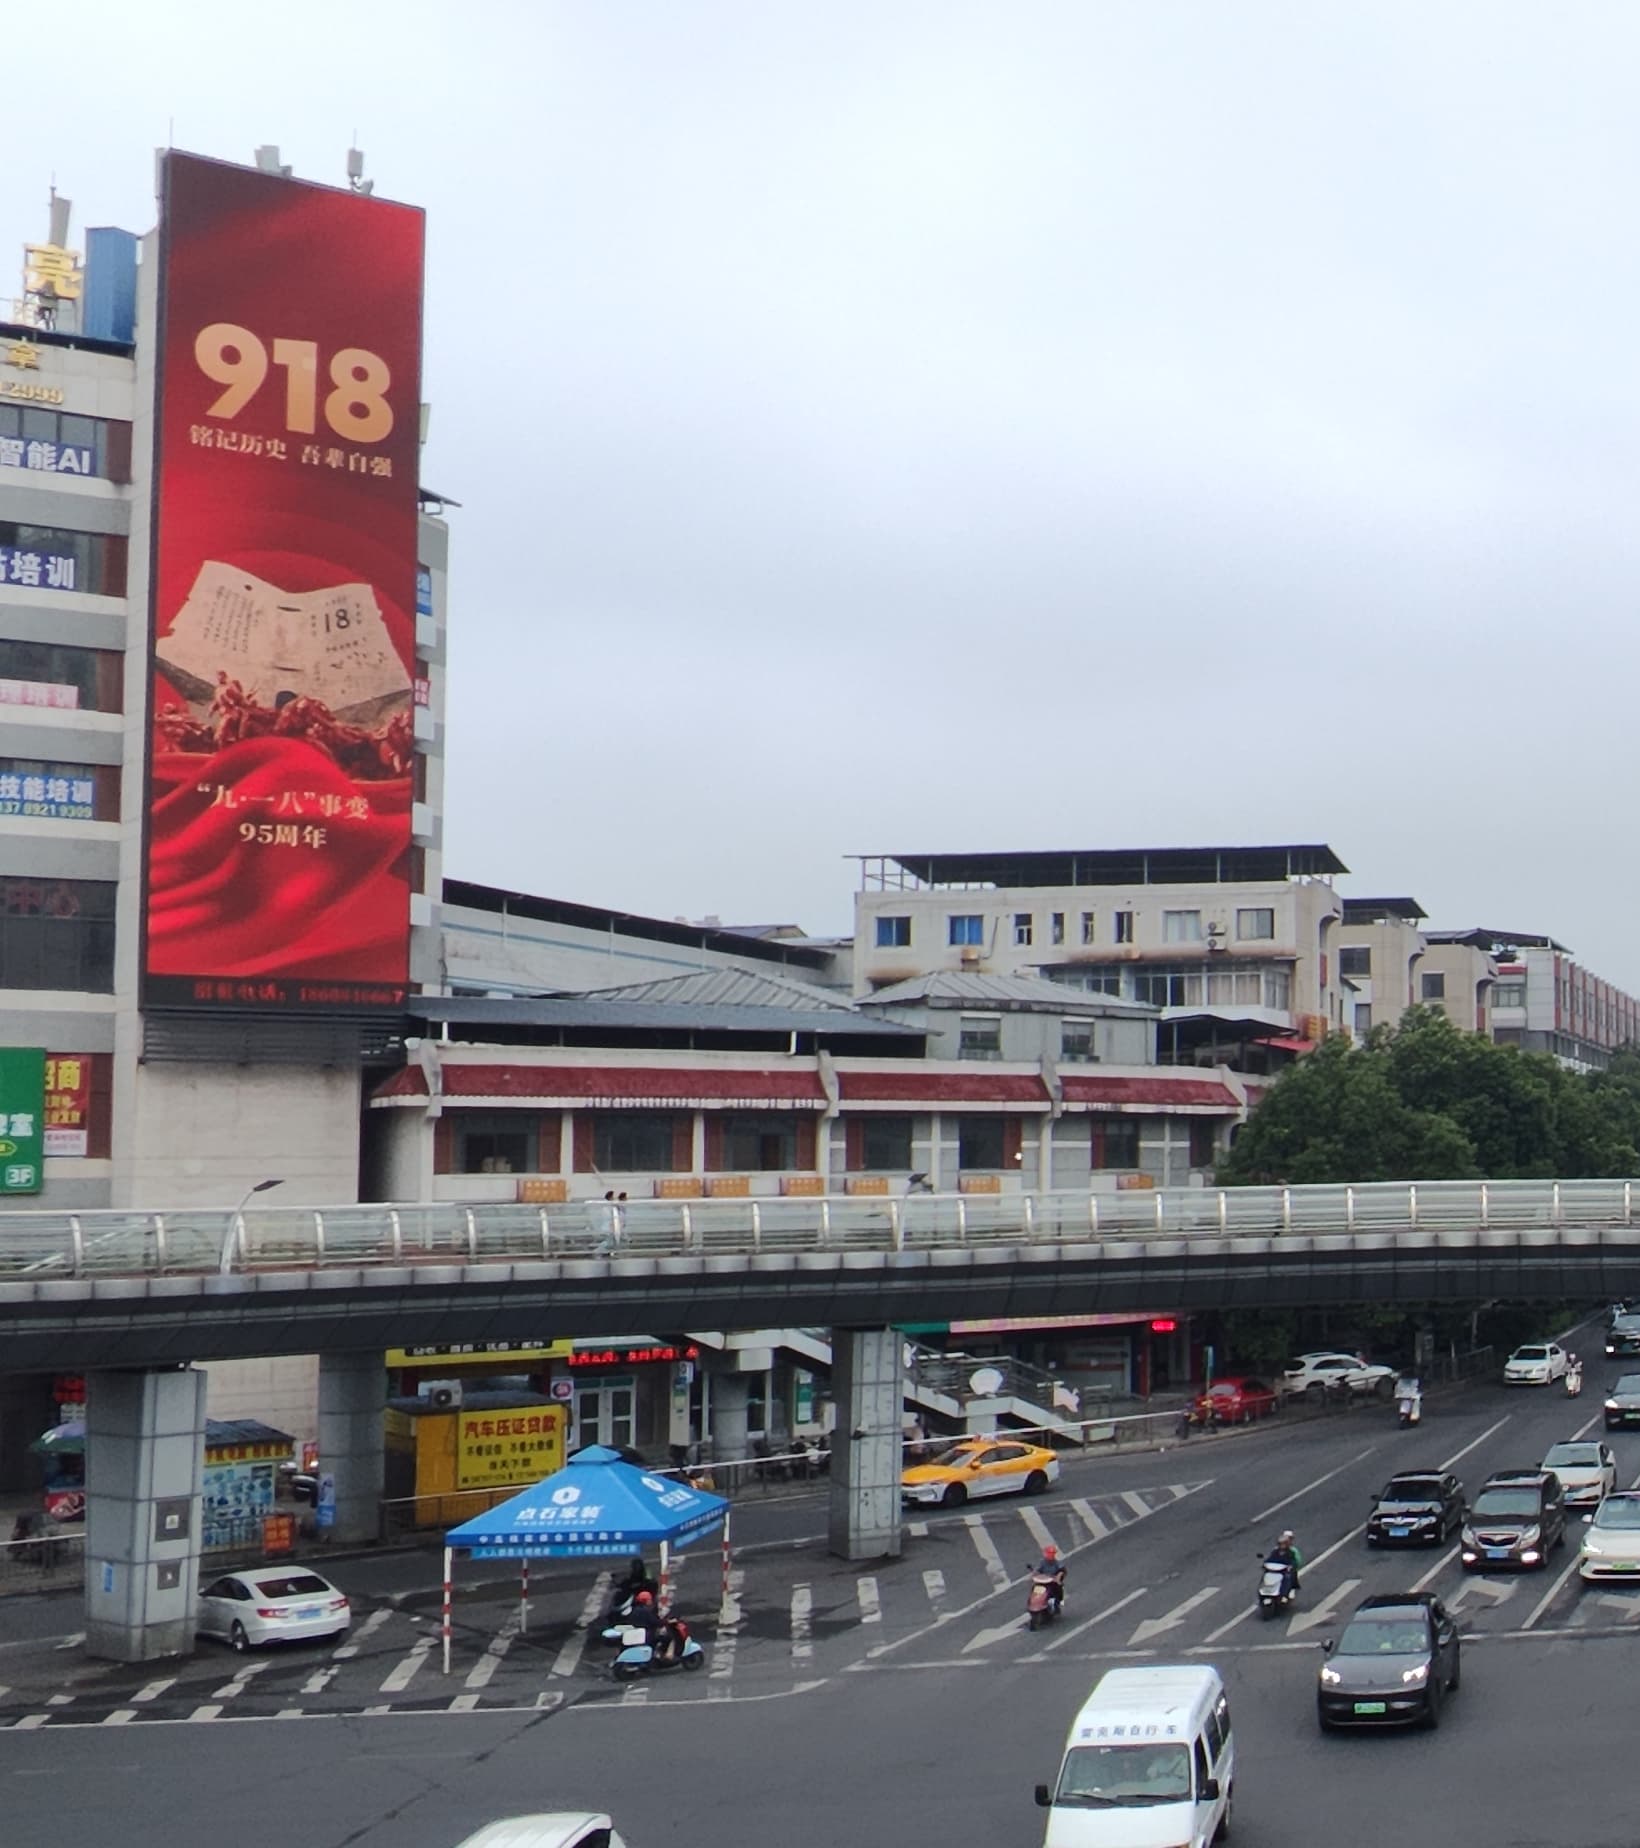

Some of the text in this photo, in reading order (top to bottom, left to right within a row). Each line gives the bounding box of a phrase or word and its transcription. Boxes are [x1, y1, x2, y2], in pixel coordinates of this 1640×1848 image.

[194, 322, 394, 443] 918
[189, 424, 393, 478] 铭记历史 吾辈自强
[239, 823, 327, 849] 95周年
